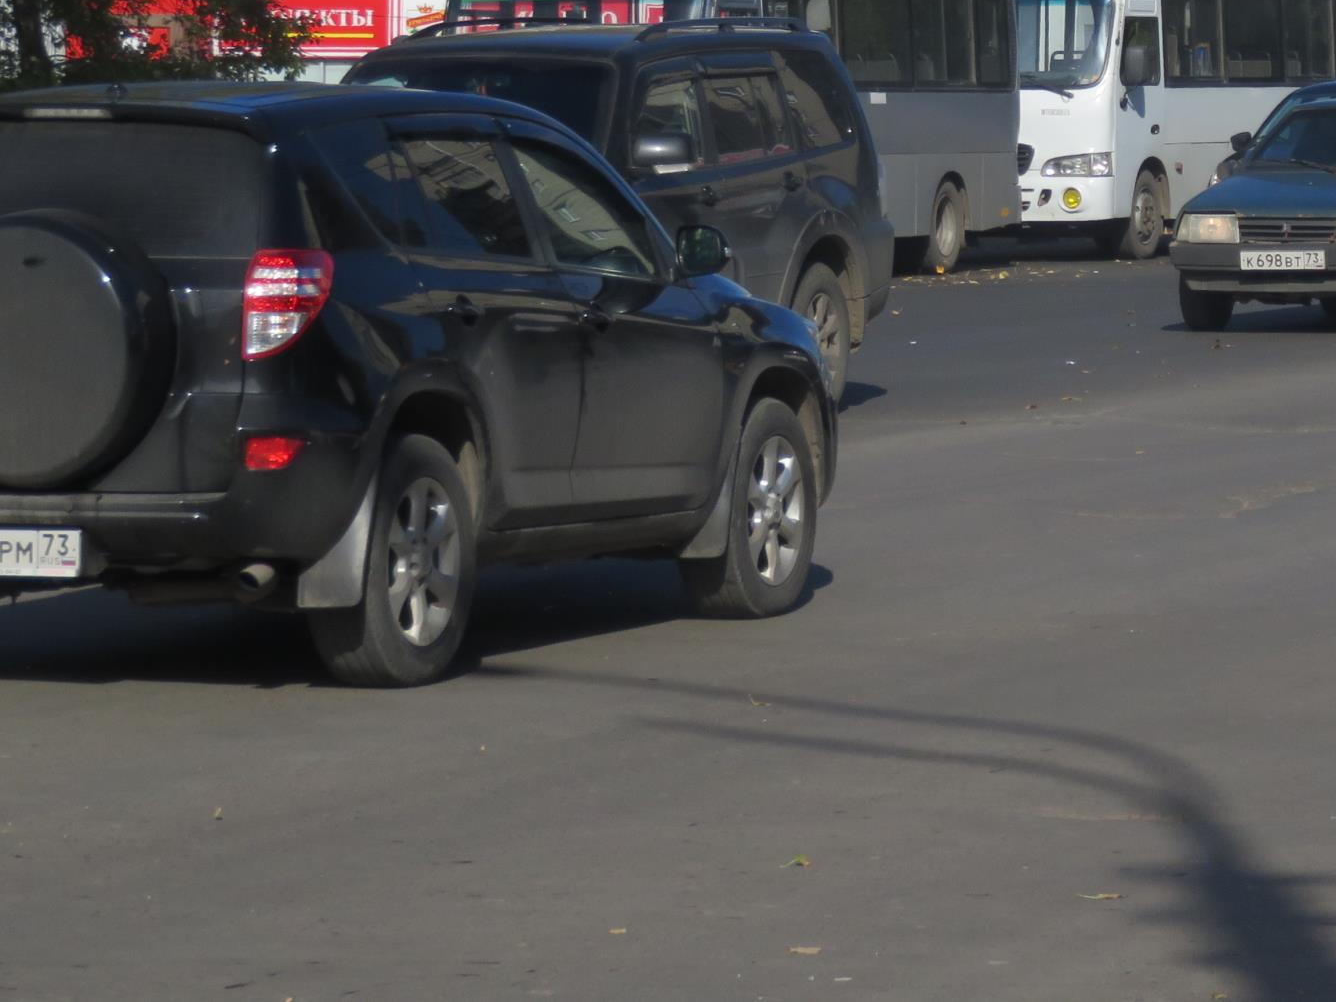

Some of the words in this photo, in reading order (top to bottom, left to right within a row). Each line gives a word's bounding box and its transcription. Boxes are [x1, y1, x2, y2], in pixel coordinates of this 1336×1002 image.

[1246, 253, 1301, 267] К698ВТ
[1305, 252, 1319, 263] 73
[42, 533, 69, 556] 73
